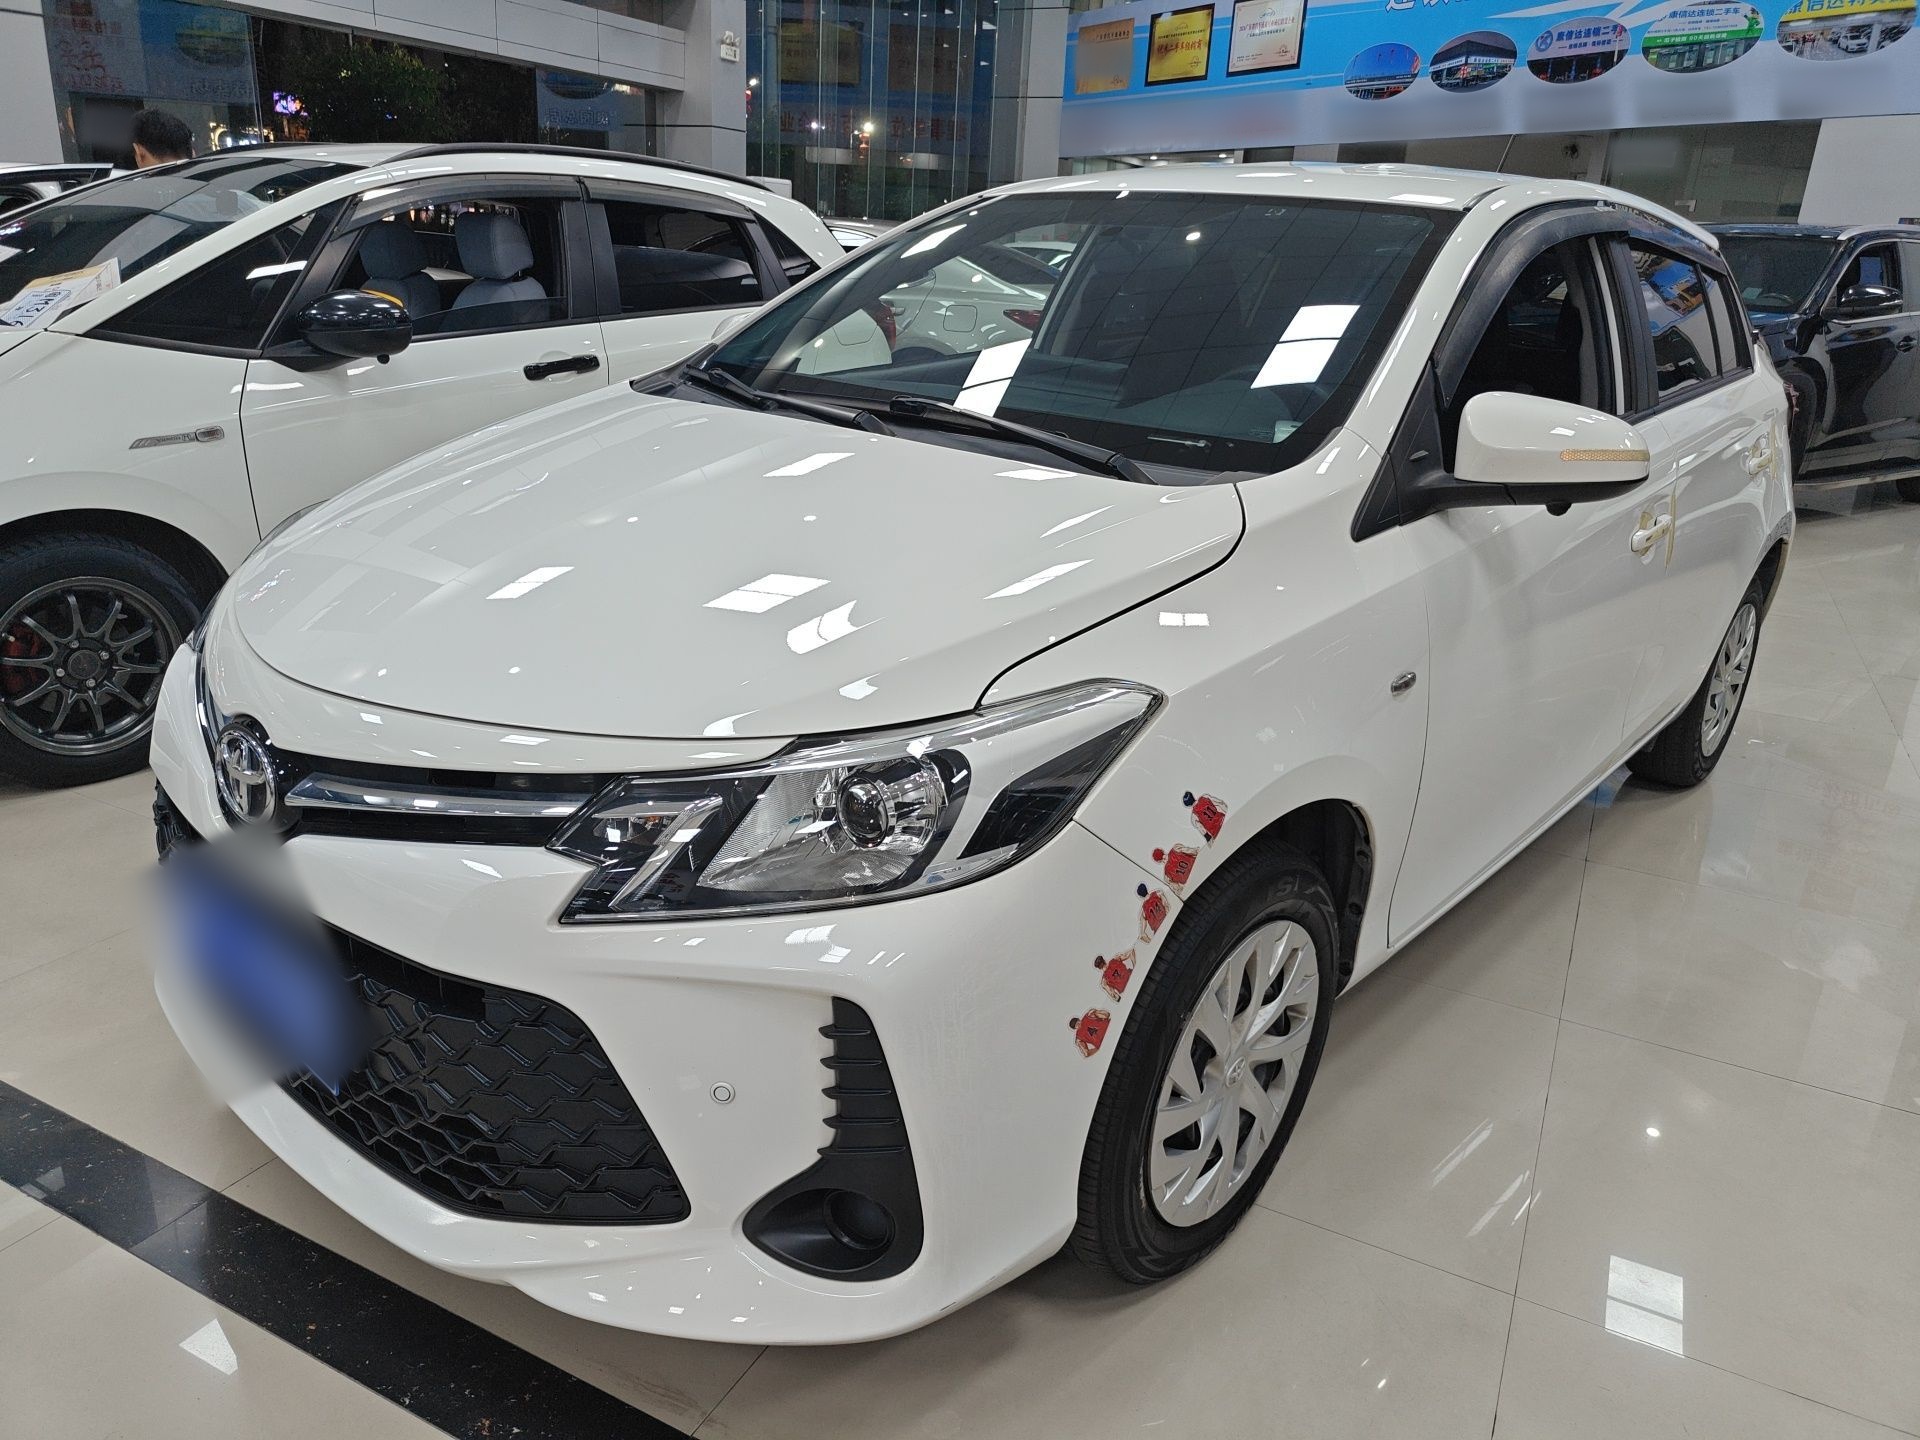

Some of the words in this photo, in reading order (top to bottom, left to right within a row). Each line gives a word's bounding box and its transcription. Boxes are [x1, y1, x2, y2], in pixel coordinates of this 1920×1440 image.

[1668, 7, 1742, 19] 康信达连锁二手车
[1202, 806, 1218, 821] 11
[1176, 860, 1188, 876] 10
[1150, 901, 1163, 919] 14
